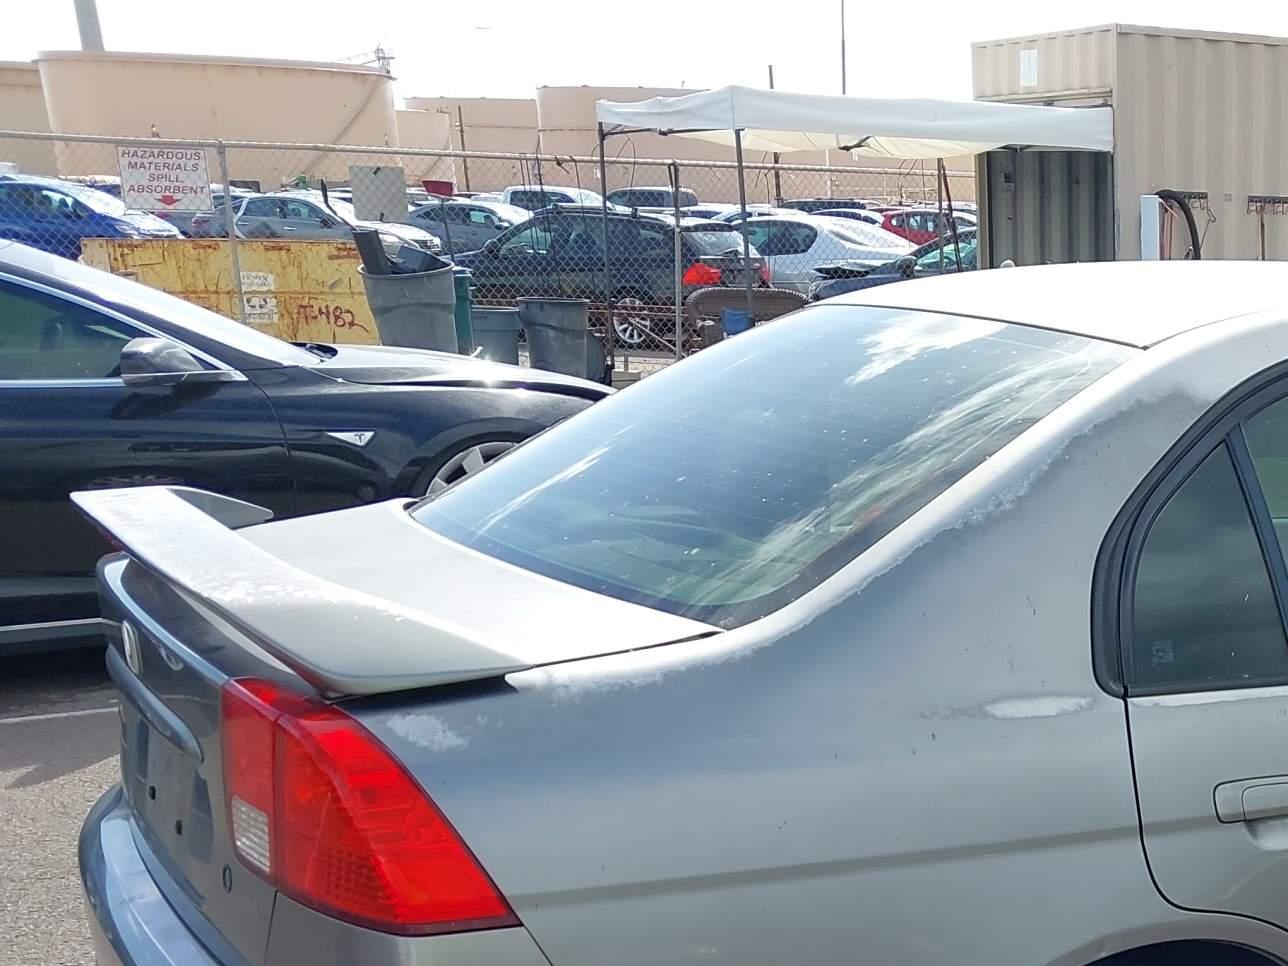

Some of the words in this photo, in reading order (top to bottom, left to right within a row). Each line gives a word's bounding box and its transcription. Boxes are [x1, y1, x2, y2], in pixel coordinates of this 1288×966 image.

[121, 149, 201, 161] HAZARDOUS
[127, 161, 199, 172] MATERIALS
[147, 173, 185, 183] SPILL
[127, 184, 206, 195] ABSORBENT
